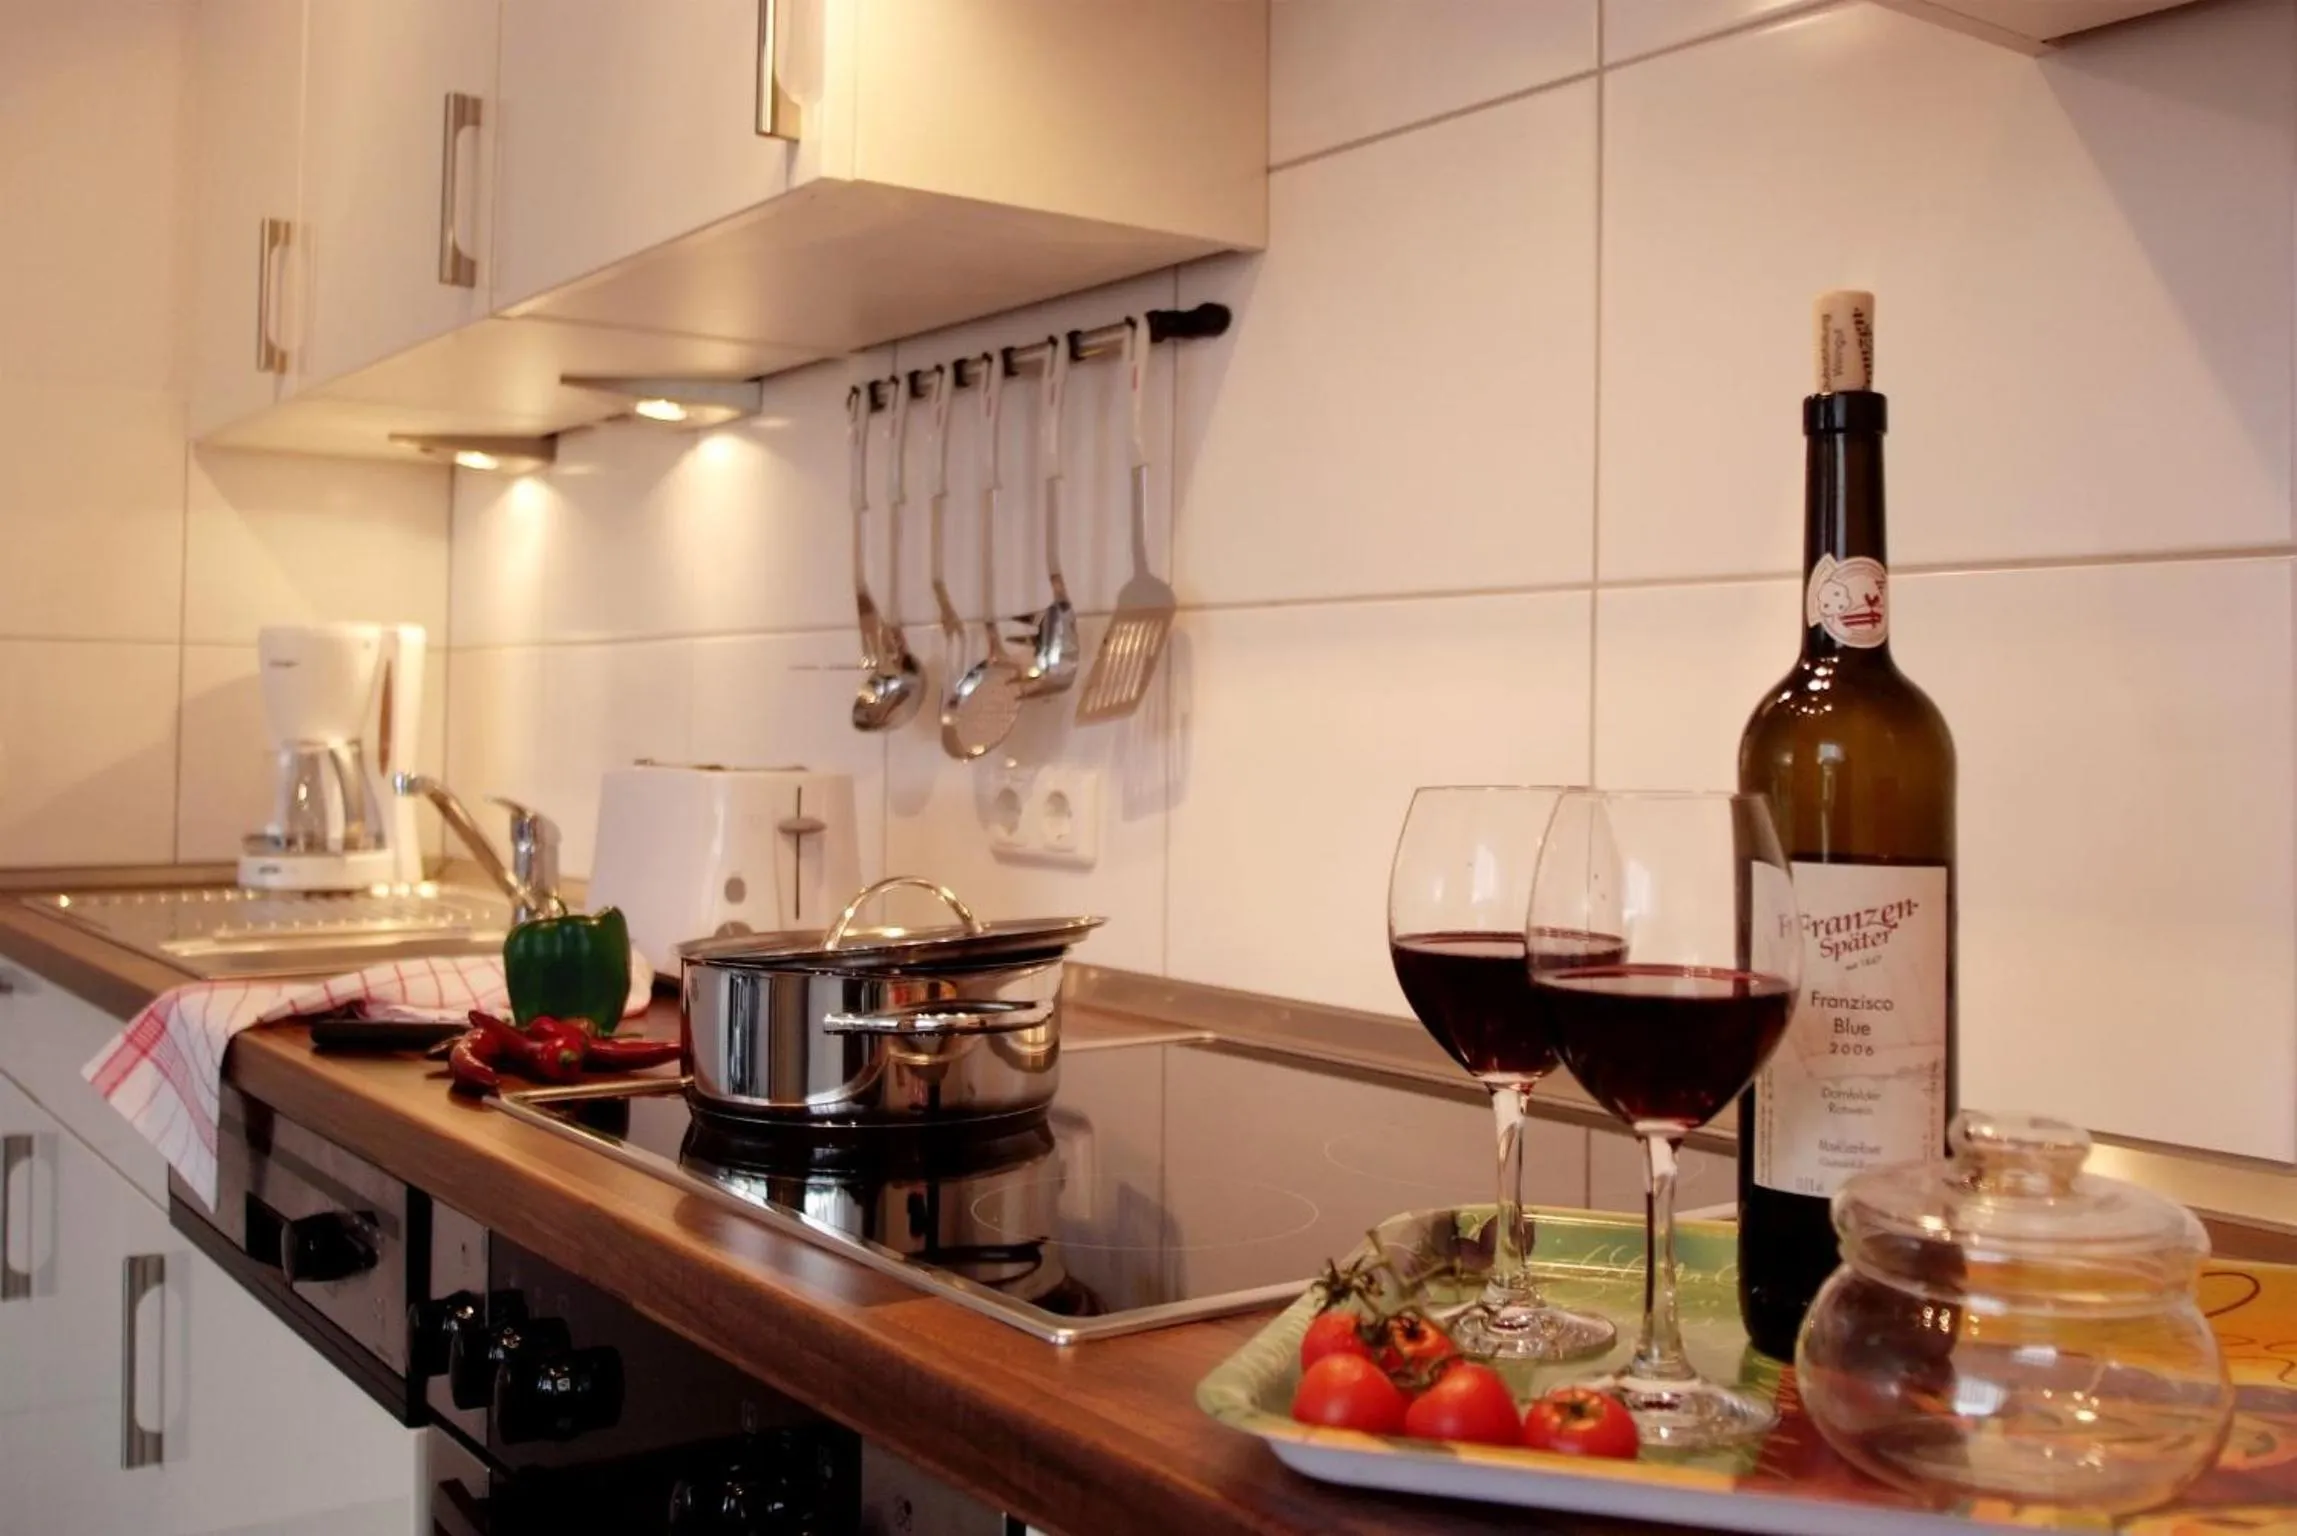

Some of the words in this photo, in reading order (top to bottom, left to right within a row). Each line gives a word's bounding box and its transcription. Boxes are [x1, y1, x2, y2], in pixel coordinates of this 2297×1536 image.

[1819, 931, 1888, 962] Später
[1811, 990, 1894, 1011] Franzisco
[1834, 1017, 1871, 1036] Blue
[1829, 1041, 1875, 1057] 2006
